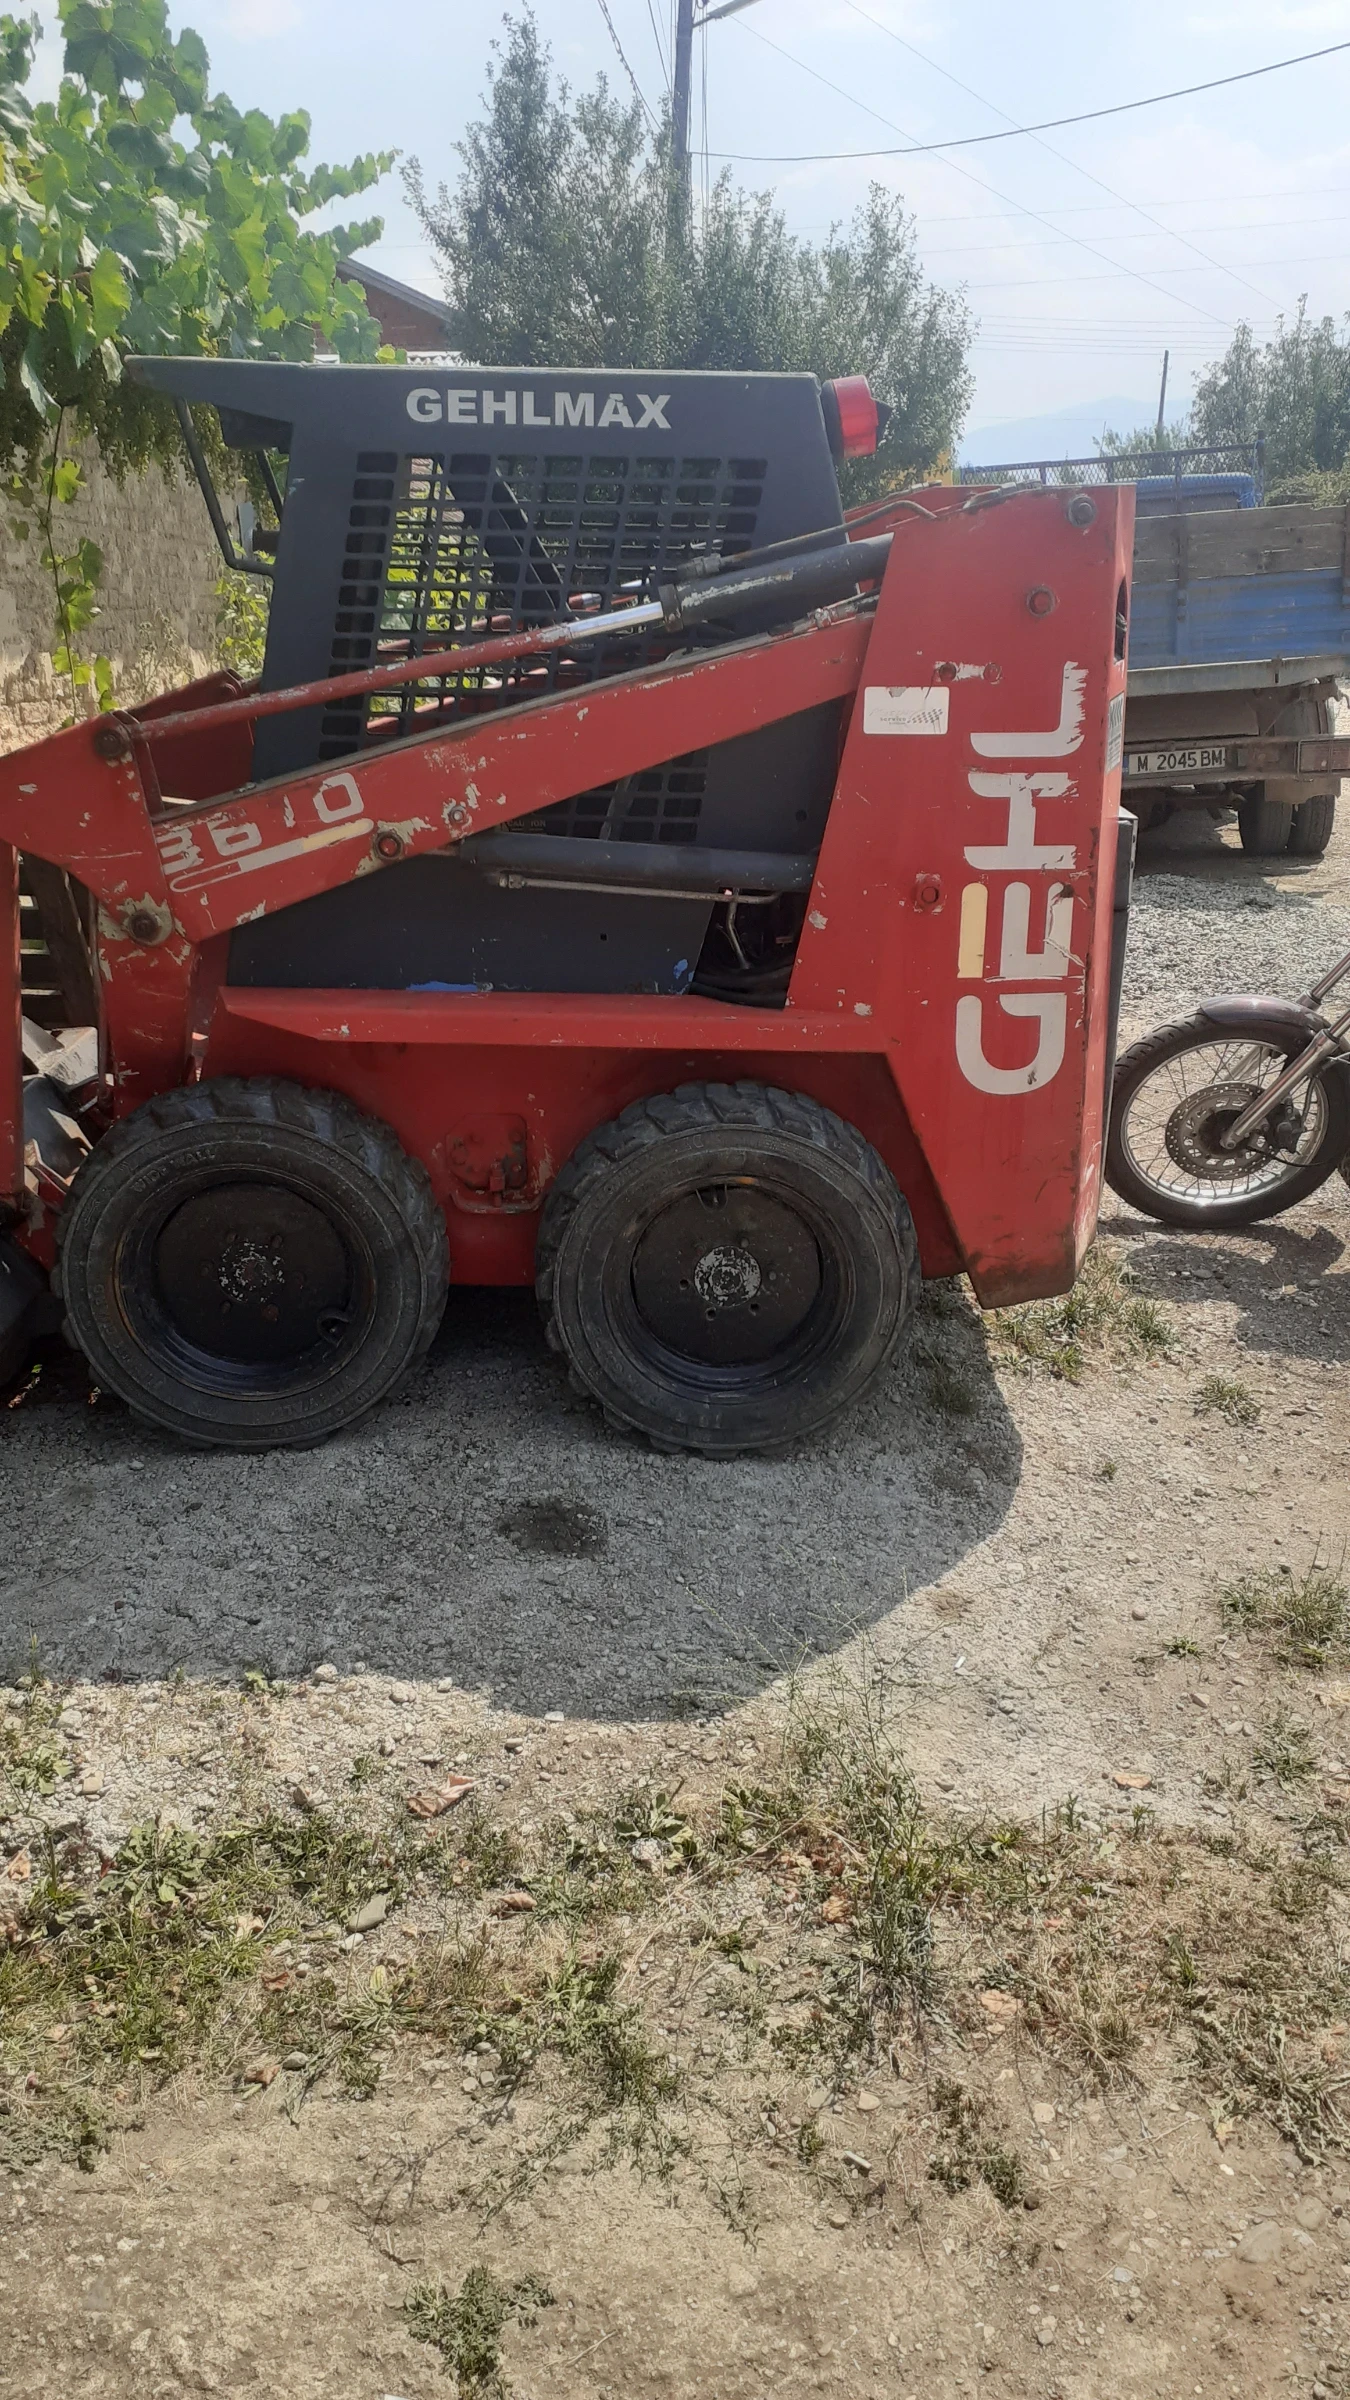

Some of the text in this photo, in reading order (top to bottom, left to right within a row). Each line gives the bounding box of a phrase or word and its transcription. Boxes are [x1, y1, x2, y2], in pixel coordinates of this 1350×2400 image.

[406, 388, 671, 429] GEHLMAX
[1137, 749, 1223, 772] M 2045 BM
[508, 819, 546, 827] CAUION
[956, 660, 1088, 1095] GEHL
